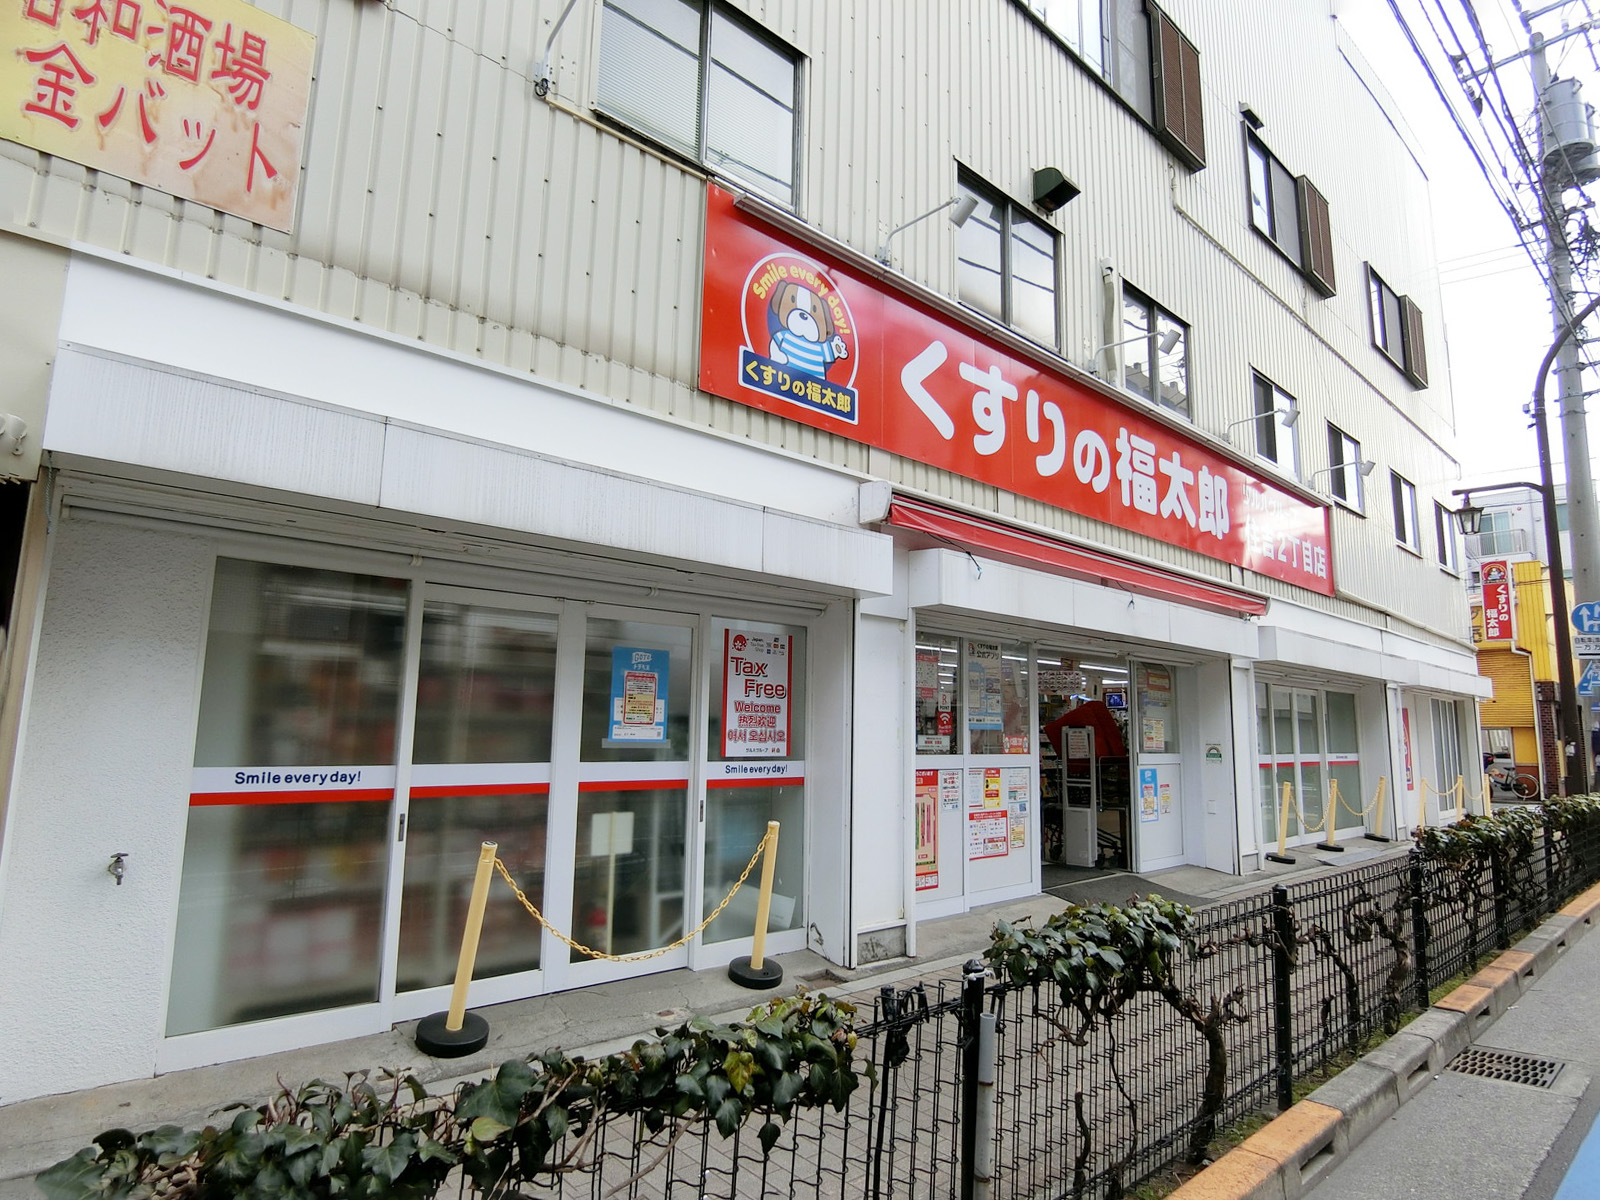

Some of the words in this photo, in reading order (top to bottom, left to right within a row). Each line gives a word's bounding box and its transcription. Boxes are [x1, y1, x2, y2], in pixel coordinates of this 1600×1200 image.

[25, 44, 278, 192] 金バット
[753, 263, 788, 300] Smile
[789, 265, 829, 297] every
[827, 296, 851, 335] day!
[745, 360, 851, 413] くすりの福太郎
[900, 340, 1230, 540] くすりの福太郎
[731, 656, 767, 677] Tax
[744, 678, 786, 698] Free
[734, 700, 781, 713] Welcome
[728, 729, 747, 743] 어서
[234, 771, 281, 784] Smile
[284, 773, 328, 786] every
[329, 770, 361, 785] day!
[725, 764, 748, 774] Smile
[749, 766, 771, 775] every
